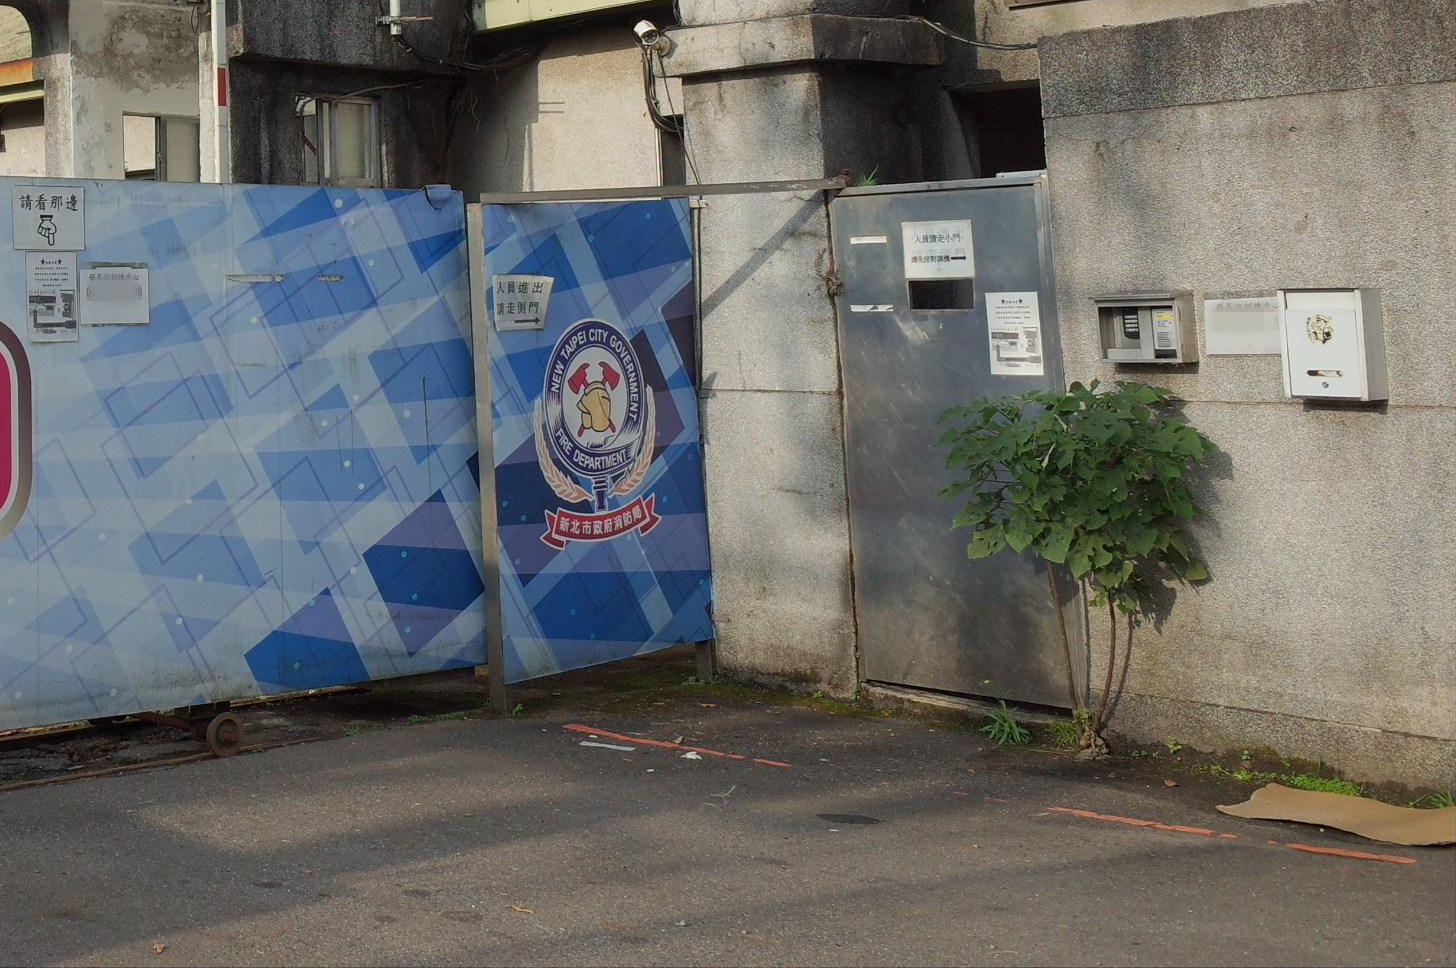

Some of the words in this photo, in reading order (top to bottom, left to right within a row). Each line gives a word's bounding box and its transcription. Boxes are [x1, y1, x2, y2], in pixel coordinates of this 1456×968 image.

[19, 193, 79, 212] 請看那邊
[496, 281, 544, 294] 人員進出
[496, 301, 540, 316] 請走側門
[550, 360, 565, 393] NEW
[560, 330, 587, 360] TAIPEI
[588, 328, 609, 344] CITY
[609, 335, 639, 422] GOVERNMENT
[554, 428, 572, 456] FIRE
[572, 448, 628, 470] DEPARTMENT
[558, 506, 643, 535] 新北市政府消防局
